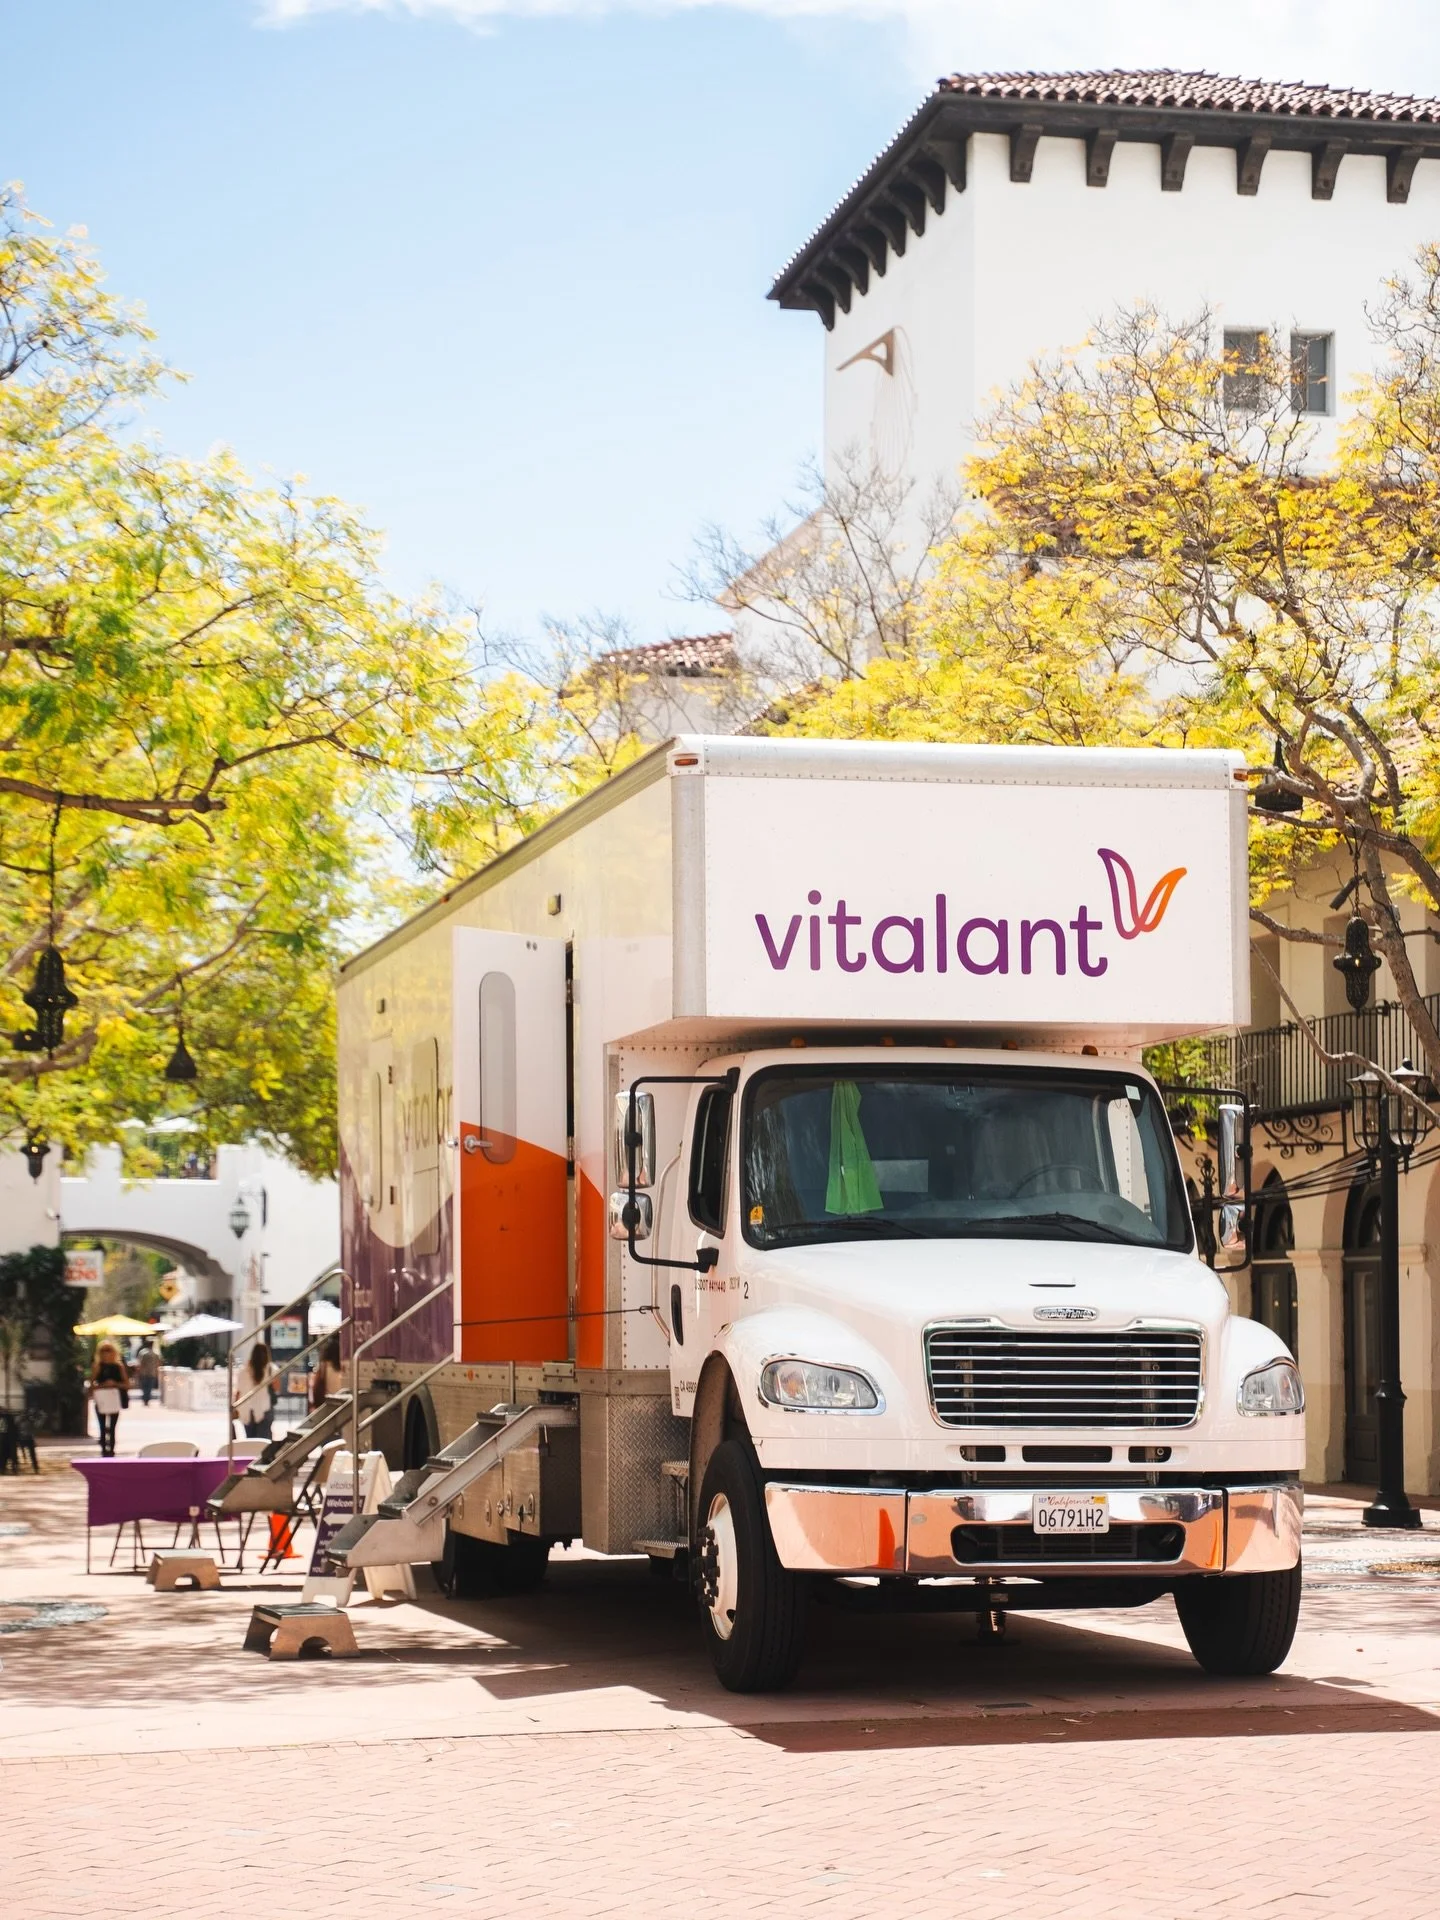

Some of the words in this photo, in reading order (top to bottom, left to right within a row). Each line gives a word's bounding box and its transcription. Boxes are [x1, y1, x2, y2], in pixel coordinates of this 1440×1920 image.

[755, 889, 1108, 977] vitalant
[744, 1281, 749, 1299] 2
[1048, 1496, 1092, 1508] California
[1038, 1508, 1104, 1528] 06791H2
